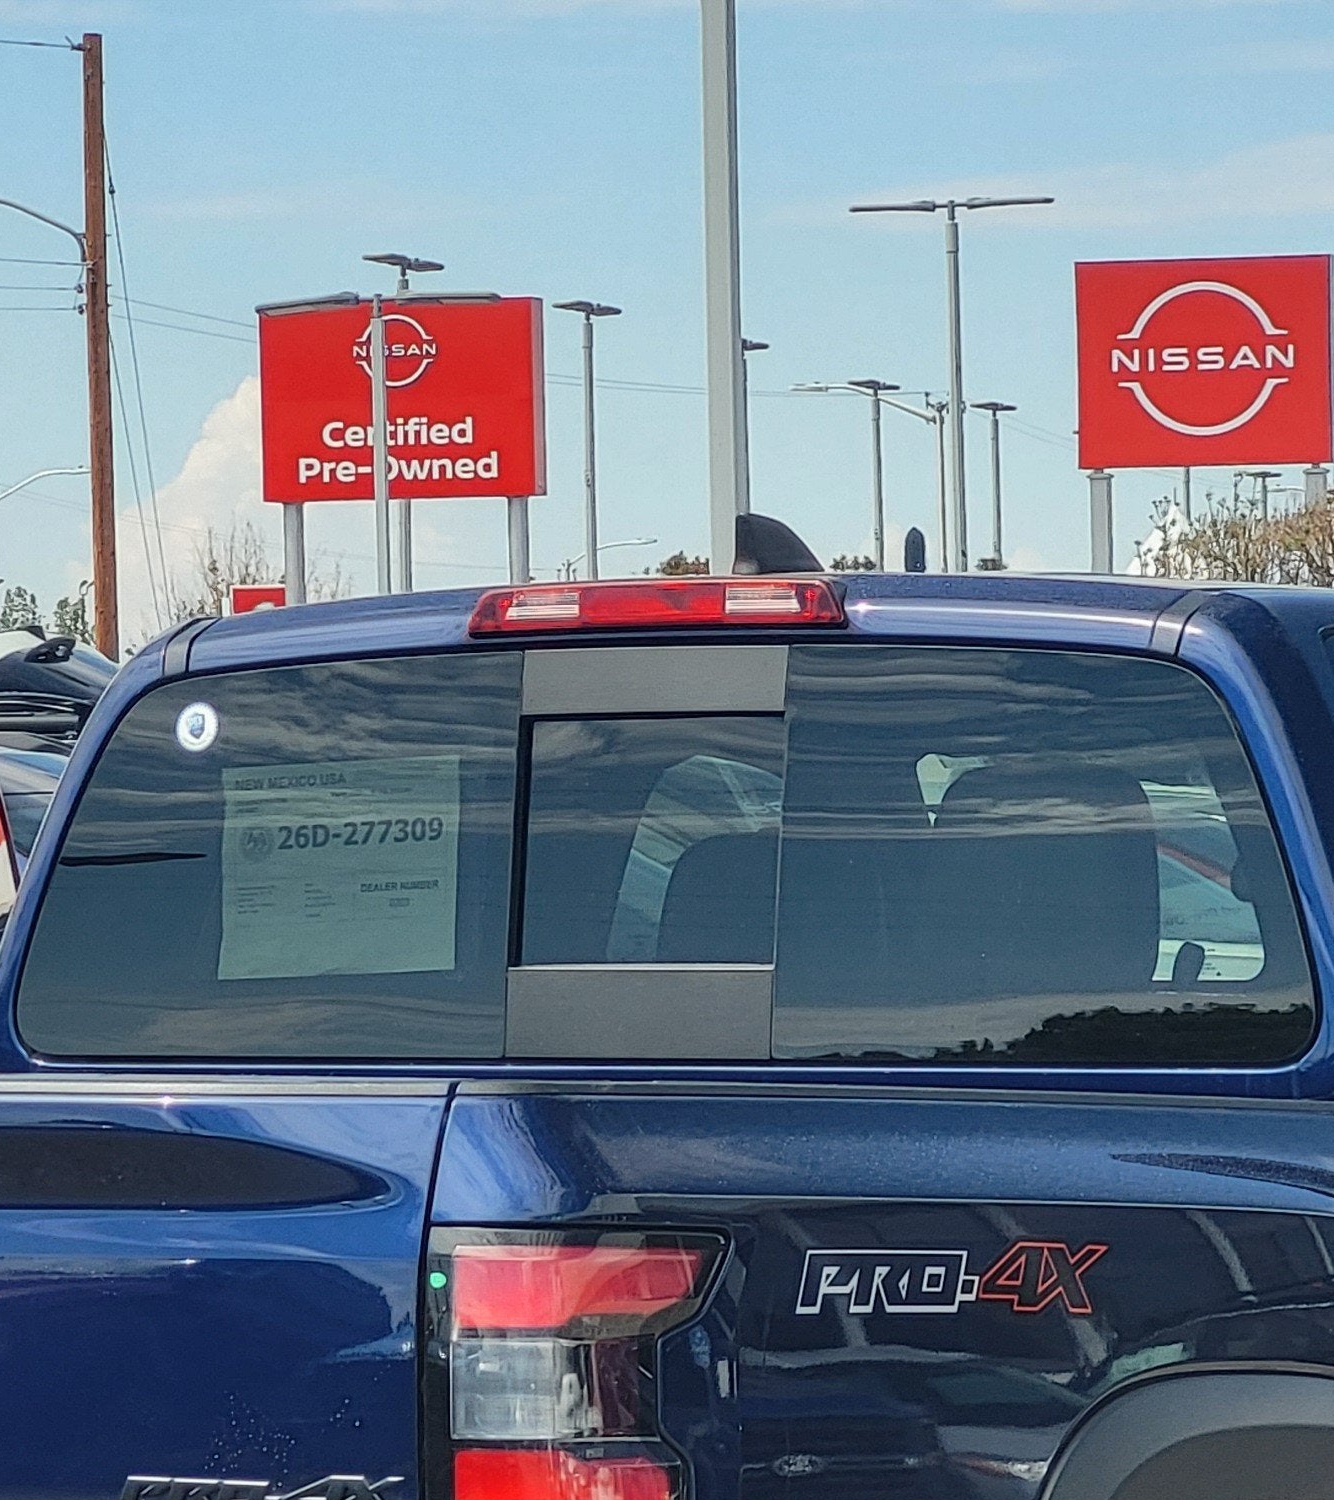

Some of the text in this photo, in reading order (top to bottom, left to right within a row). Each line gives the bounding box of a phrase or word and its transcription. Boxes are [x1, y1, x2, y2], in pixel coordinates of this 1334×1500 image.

[1111, 344, 1294, 373] NISSAN
[319, 773, 347, 785] USA
[277, 817, 443, 849] 26D-277309
[795, 1241, 1109, 1314] PRO-4X
